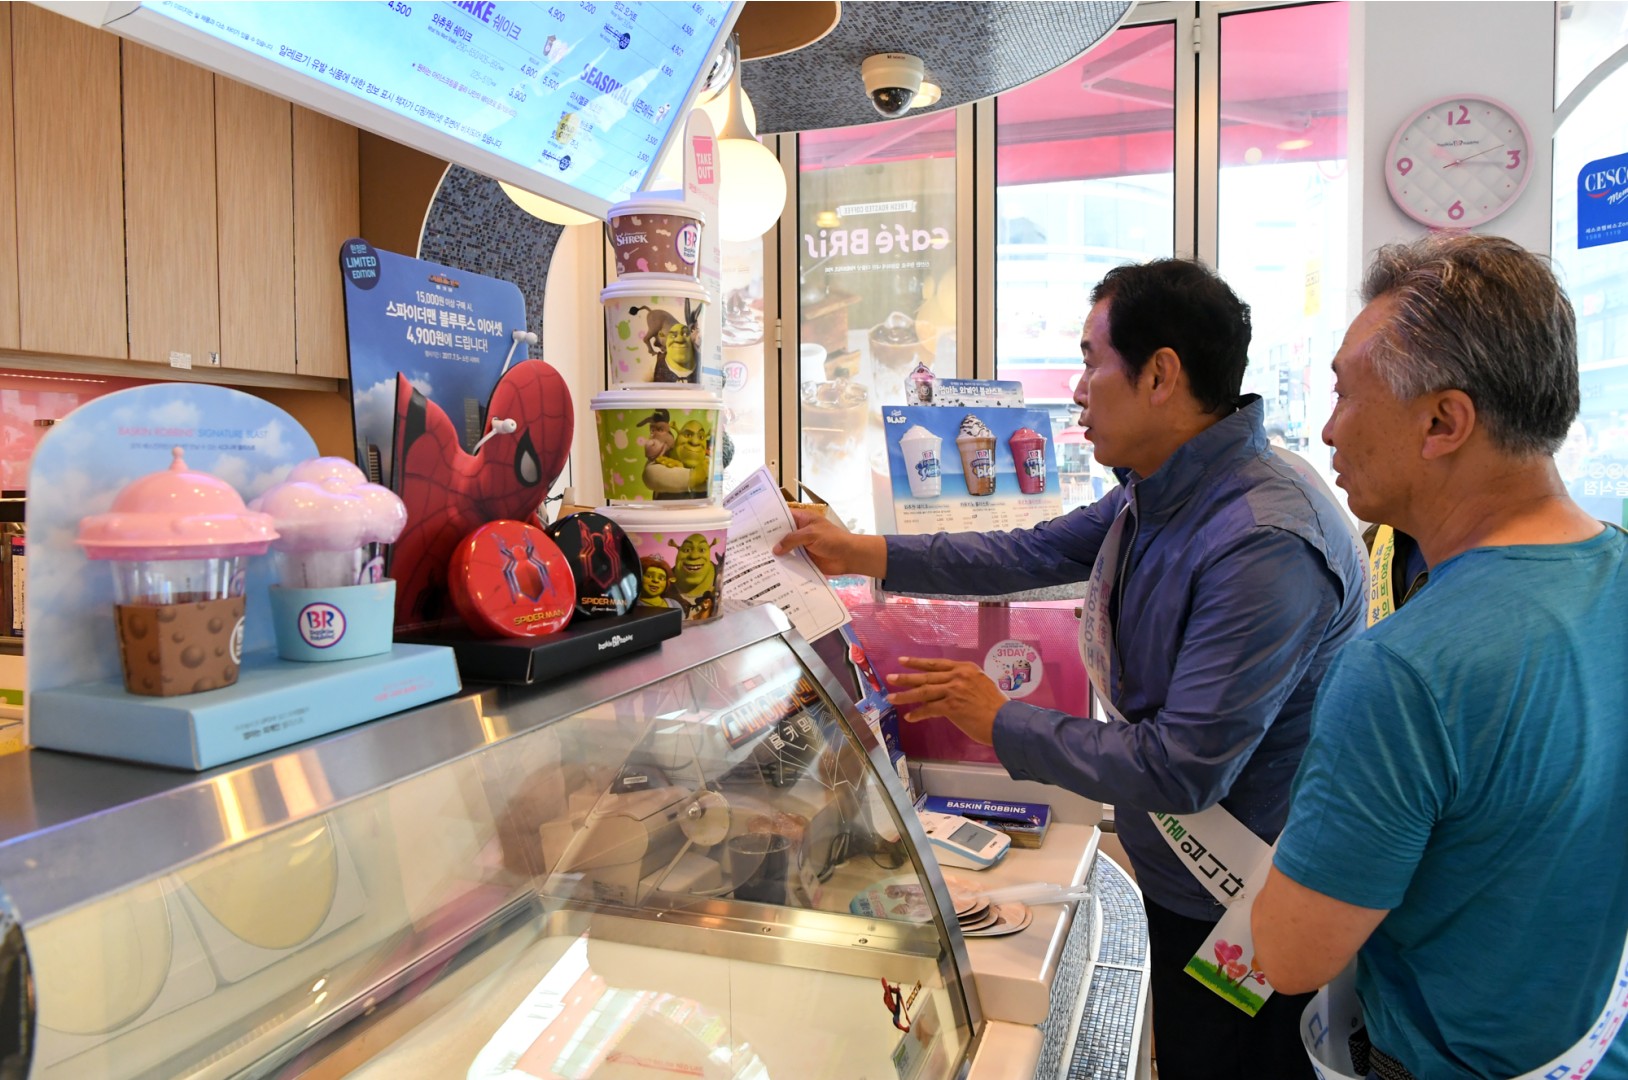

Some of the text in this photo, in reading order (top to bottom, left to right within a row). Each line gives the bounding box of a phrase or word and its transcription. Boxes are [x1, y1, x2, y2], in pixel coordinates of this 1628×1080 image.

[492, 13, 522, 41] 쉐이크
[279, 44, 311, 66] 알레르기
[311, 59, 328, 74] 유발
[329, 66, 351, 84] 식품에
[351, 76, 366, 90] 대한
[366, 82, 380, 96] 정보
[380, 89, 395, 103] 표시
[580, 63, 631, 106] SEASONAL
[1447, 104, 1471, 126] 12
[696, 153, 712, 165] TAKE
[1396, 157, 1413, 176] 9
[1505, 149, 1521, 169] 3
[698, 166, 713, 179] OUT
[1585, 166, 1628, 192] CESC
[1447, 200, 1465, 220] 6
[346, 256, 377, 268] LIMITED
[352, 269, 376, 280] EDITION
[416, 290, 445, 307] 15,000원
[444, 298, 455, 307] 이상
[456, 299, 466, 311] 구매
[386, 300, 503, 337] 스파이더맨 블루투스 이어셋
[406, 325, 488, 353] 4,900원에 드립니다!
[886, 416, 907, 424] BLAST
[198, 429, 243, 439] SIGNATURE
[245, 430, 268, 440] BLAST
[306, 610, 334, 628] BR
[514, 609, 564, 626] SPIDER-MAN
[997, 648, 1026, 657] 31DAY
[946, 801, 1027, 814] BASKIN ROBBINS
